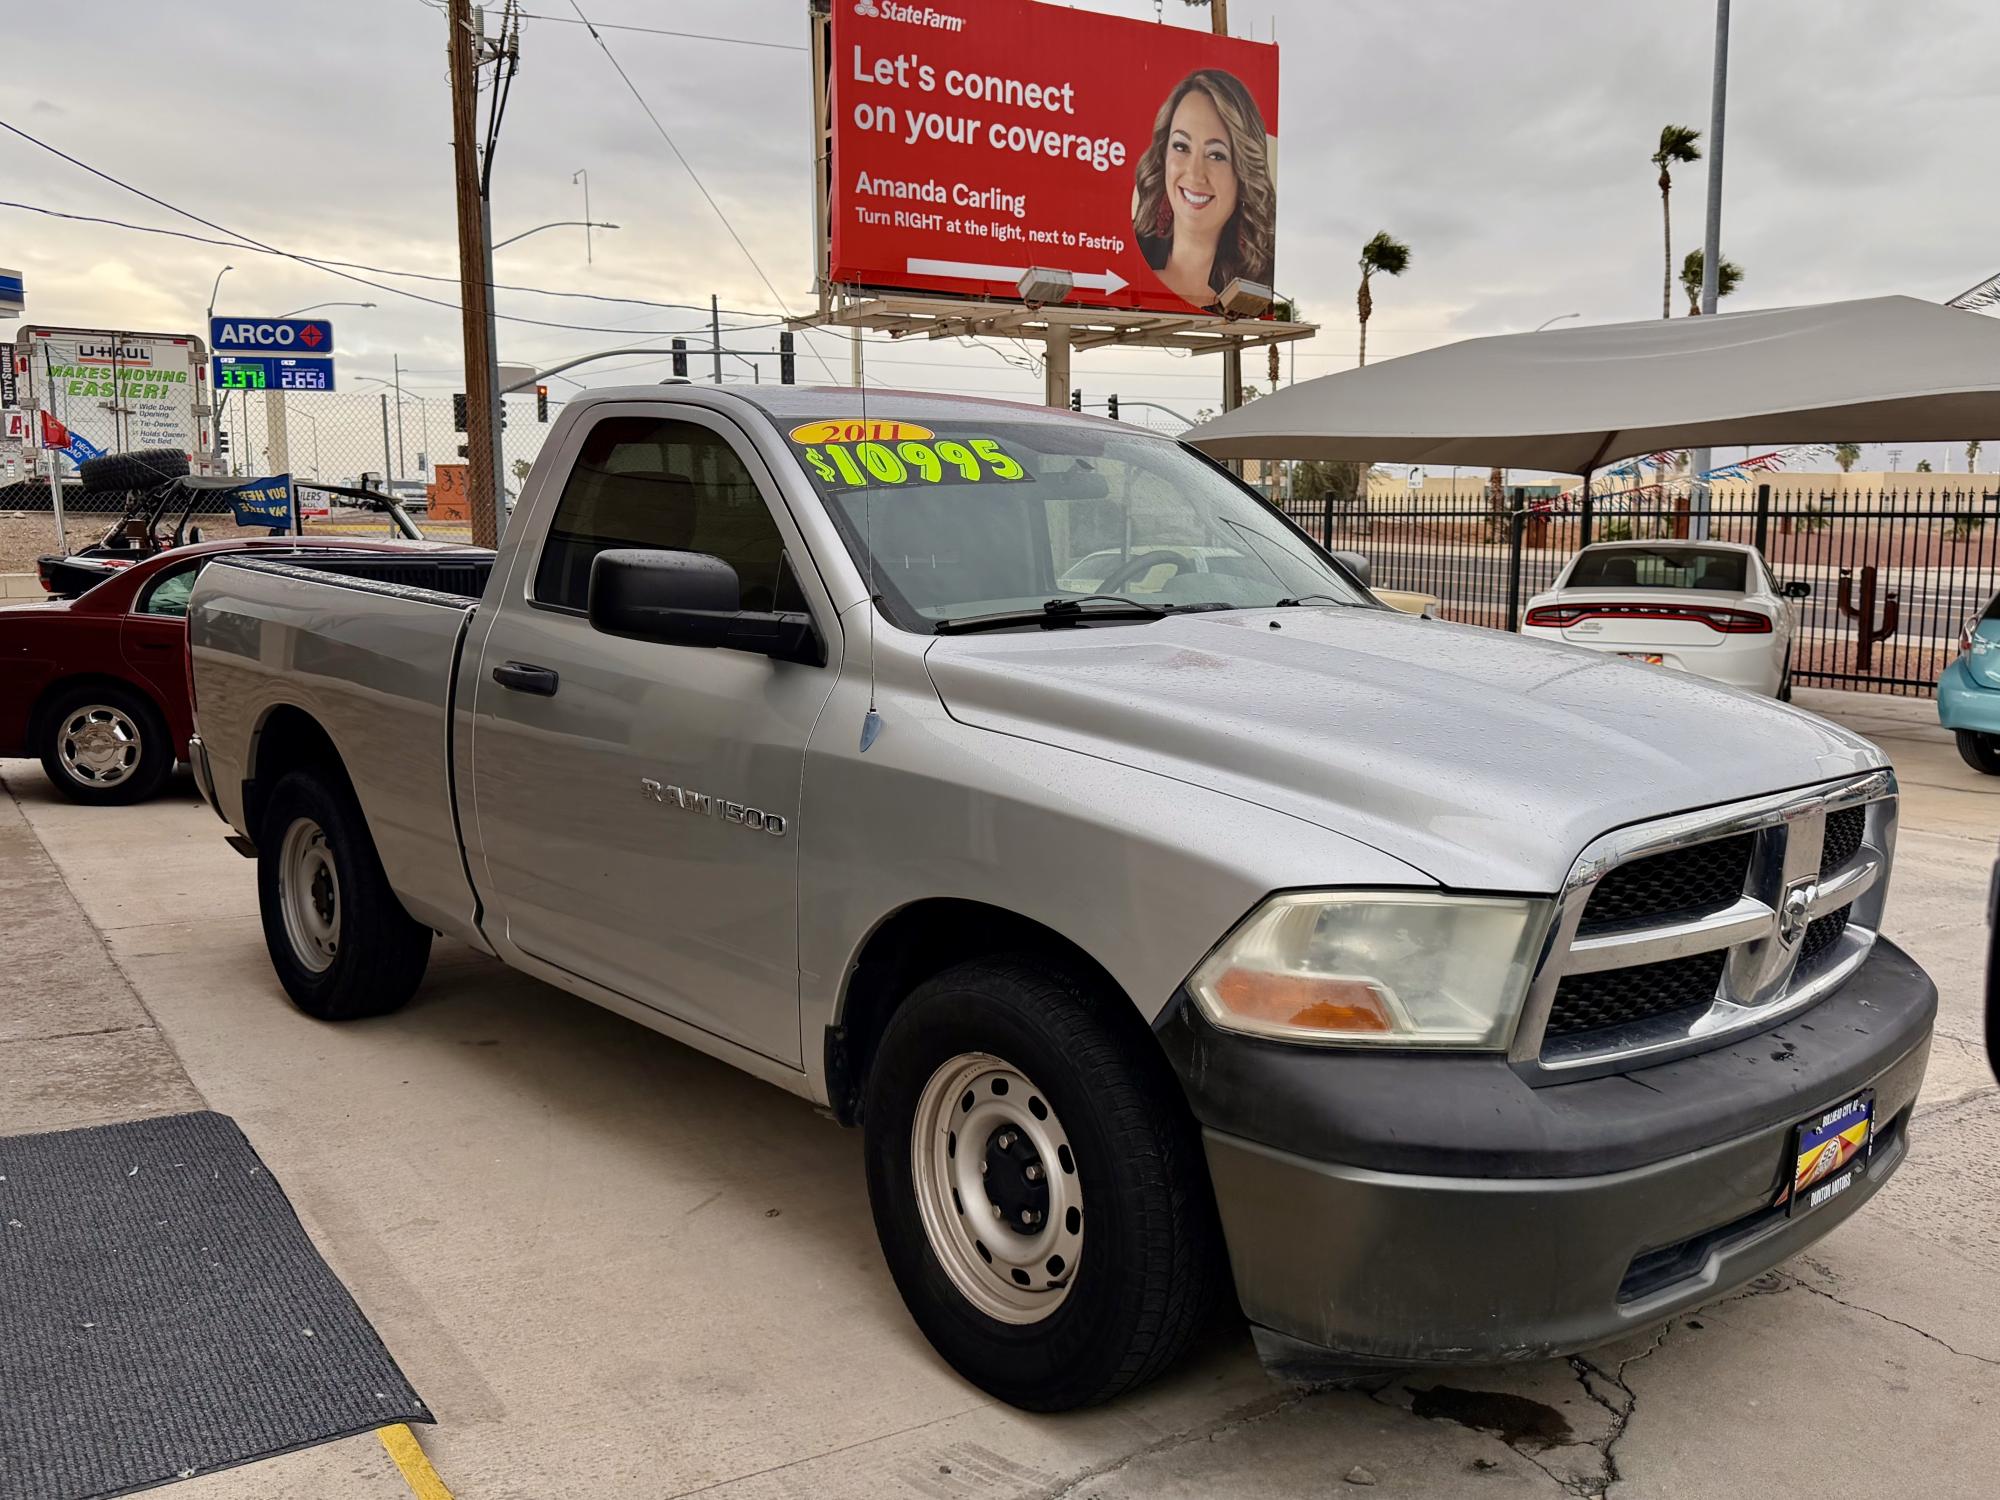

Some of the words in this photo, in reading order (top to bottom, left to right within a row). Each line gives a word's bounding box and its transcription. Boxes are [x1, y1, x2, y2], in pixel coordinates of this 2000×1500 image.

[854, 45, 936, 92] Let's
[945, 70, 1075, 115] connect
[854, 103, 896, 133] on
[905, 109, 981, 145] your
[988, 123, 1126, 172] coverage
[855, 171, 947, 203] Amanda
[952, 183, 1026, 218] Carling
[855, 206, 891, 226] Turn
[895, 211, 943, 231] RIGHT
[946, 219, 962, 234] at
[965, 219, 988, 236] the
[991, 222, 1026, 243] light,
[1029, 229, 1059, 245] next
[1062, 231, 1076, 246] to
[1078, 232, 1125, 254] Fastrip
[220, 324, 295, 345] ARCO
[79, 345, 150, 360] U-HAUL
[46, 365, 112, 380] MAKES
[116, 367, 188, 384] MOVING
[75, 440, 97, 459] DECKS
[821, 424, 900, 443] 2011
[66, 446, 82, 459] OAD
[805, 440, 1024, 486] $10995
[641, 777, 712, 816] RAM
[716, 798, 788, 836] 1500
